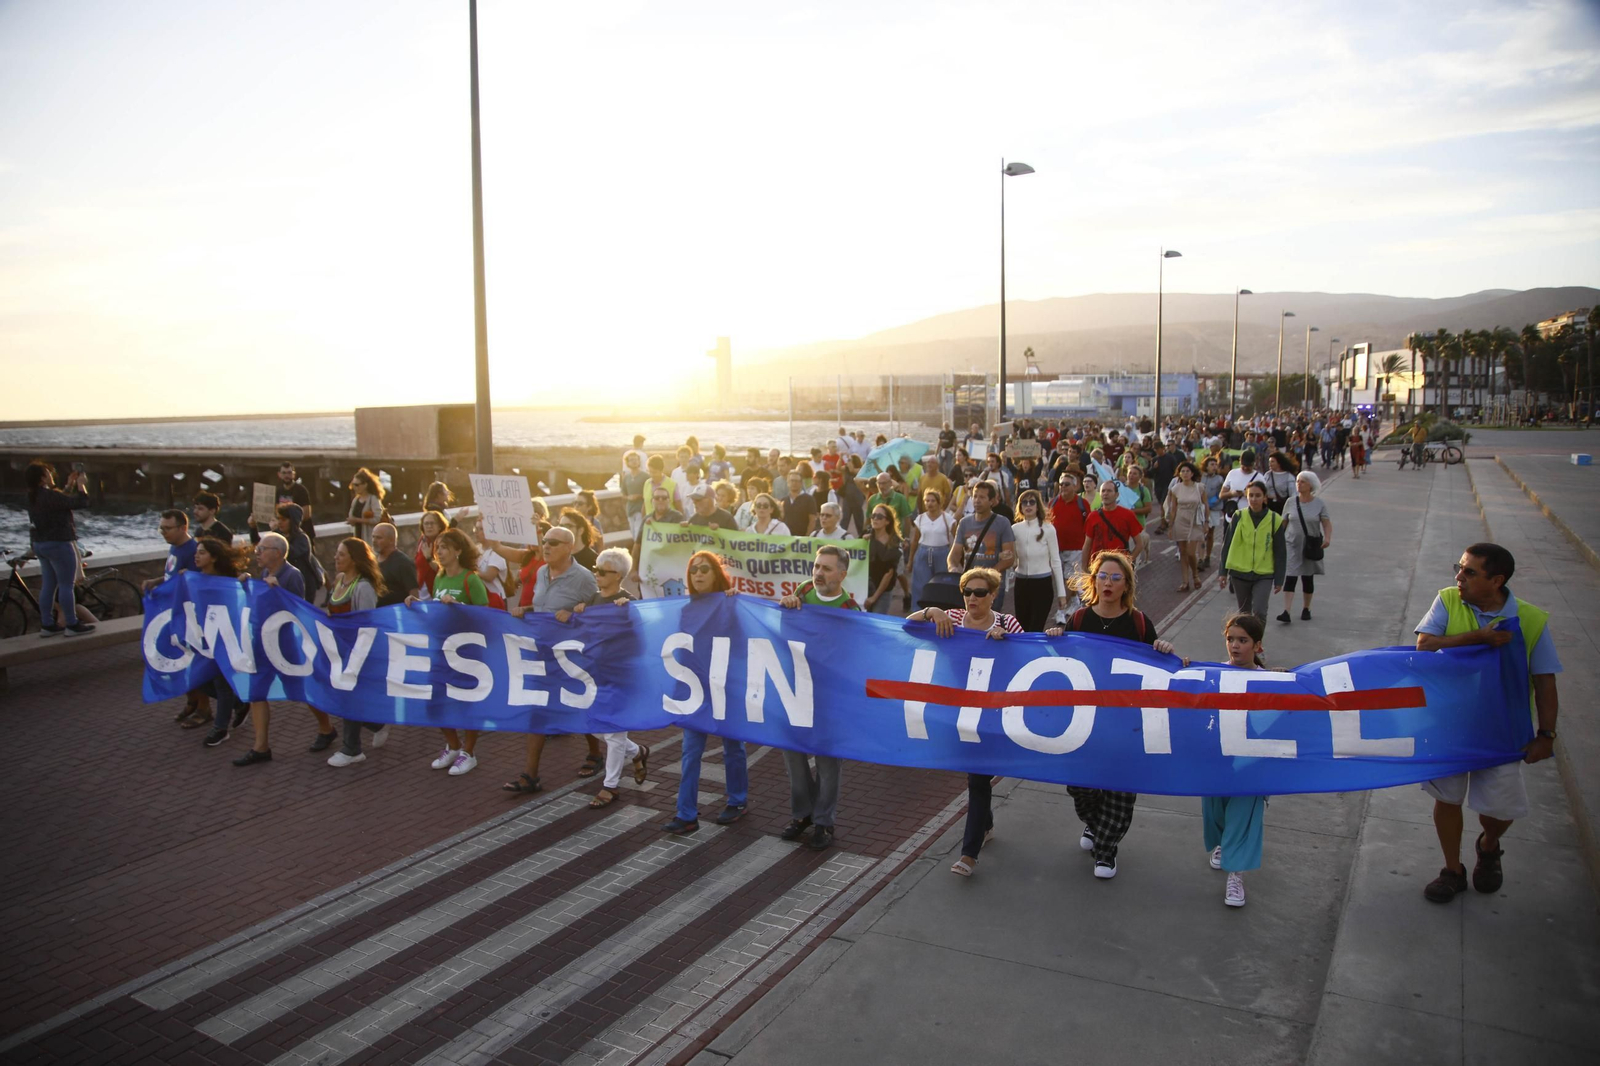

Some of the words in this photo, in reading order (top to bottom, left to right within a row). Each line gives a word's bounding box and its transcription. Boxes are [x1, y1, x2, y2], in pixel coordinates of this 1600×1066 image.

[501, 479, 521, 499] GATA
[495, 500, 508, 514] NO
[646, 528, 663, 543] Los
[666, 530, 715, 545] vecinos
[718, 537, 726, 550] y
[729, 538, 786, 554] vecinas
[791, 539, 812, 554] del
[746, 558, 814, 578] QUEREM
[660, 632, 814, 728] SIN
[903, 649, 1415, 759] HOTEL
